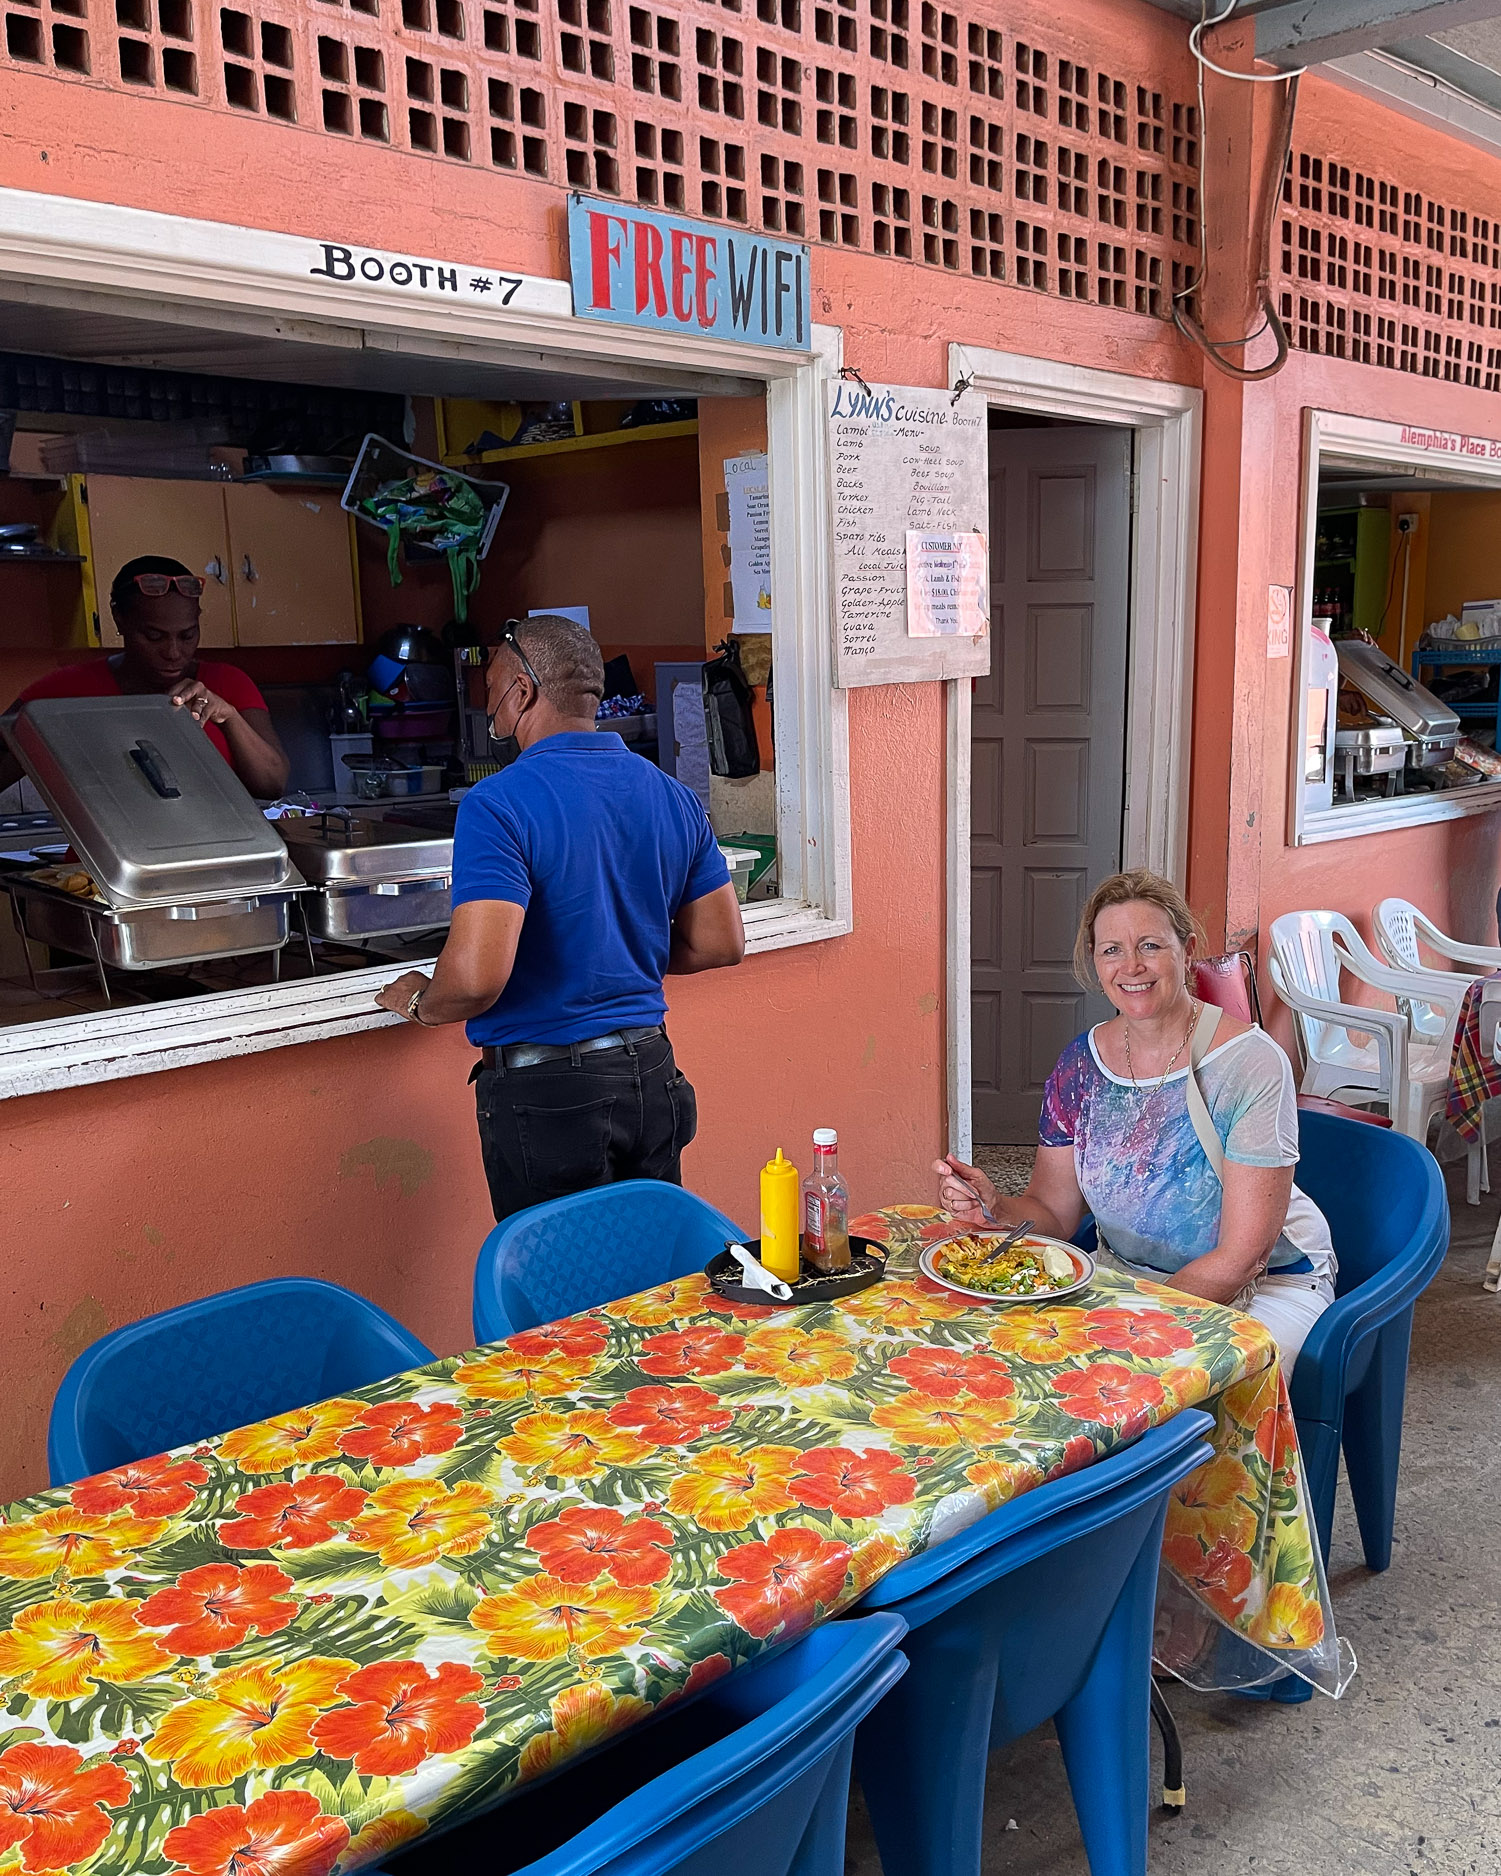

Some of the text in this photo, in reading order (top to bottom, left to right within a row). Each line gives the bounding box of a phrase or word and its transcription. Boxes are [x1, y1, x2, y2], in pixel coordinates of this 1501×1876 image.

[310, 243, 458, 293] BOOTH
[585, 210, 804, 344] FREE WIFI
[831, 385, 896, 422] LYNN'S
[836, 424, 870, 436] Lambi
[836, 438, 864, 448] Lamb
[1400, 427, 1456, 451] Alemphia's
[1460, 435, 1486, 456] Place
[836, 452, 861, 461] Pork
[836, 478, 864, 488] Backs
[837, 492, 870, 502] Turkey
[838, 505, 874, 514] Chicken
[906, 506, 932, 516] Lamb
[836, 518, 857, 528] Fish
[844, 544, 866, 556] All
[872, 548, 900, 556] Meals
[921, 541, 952, 551] CUSTOMER
[840, 574, 886, 582] Passion
[841, 610, 892, 619] Tamerine
[843, 622, 874, 634] Guava
[843, 634, 877, 644] Sorrel
[843, 646, 875, 656] Mango
